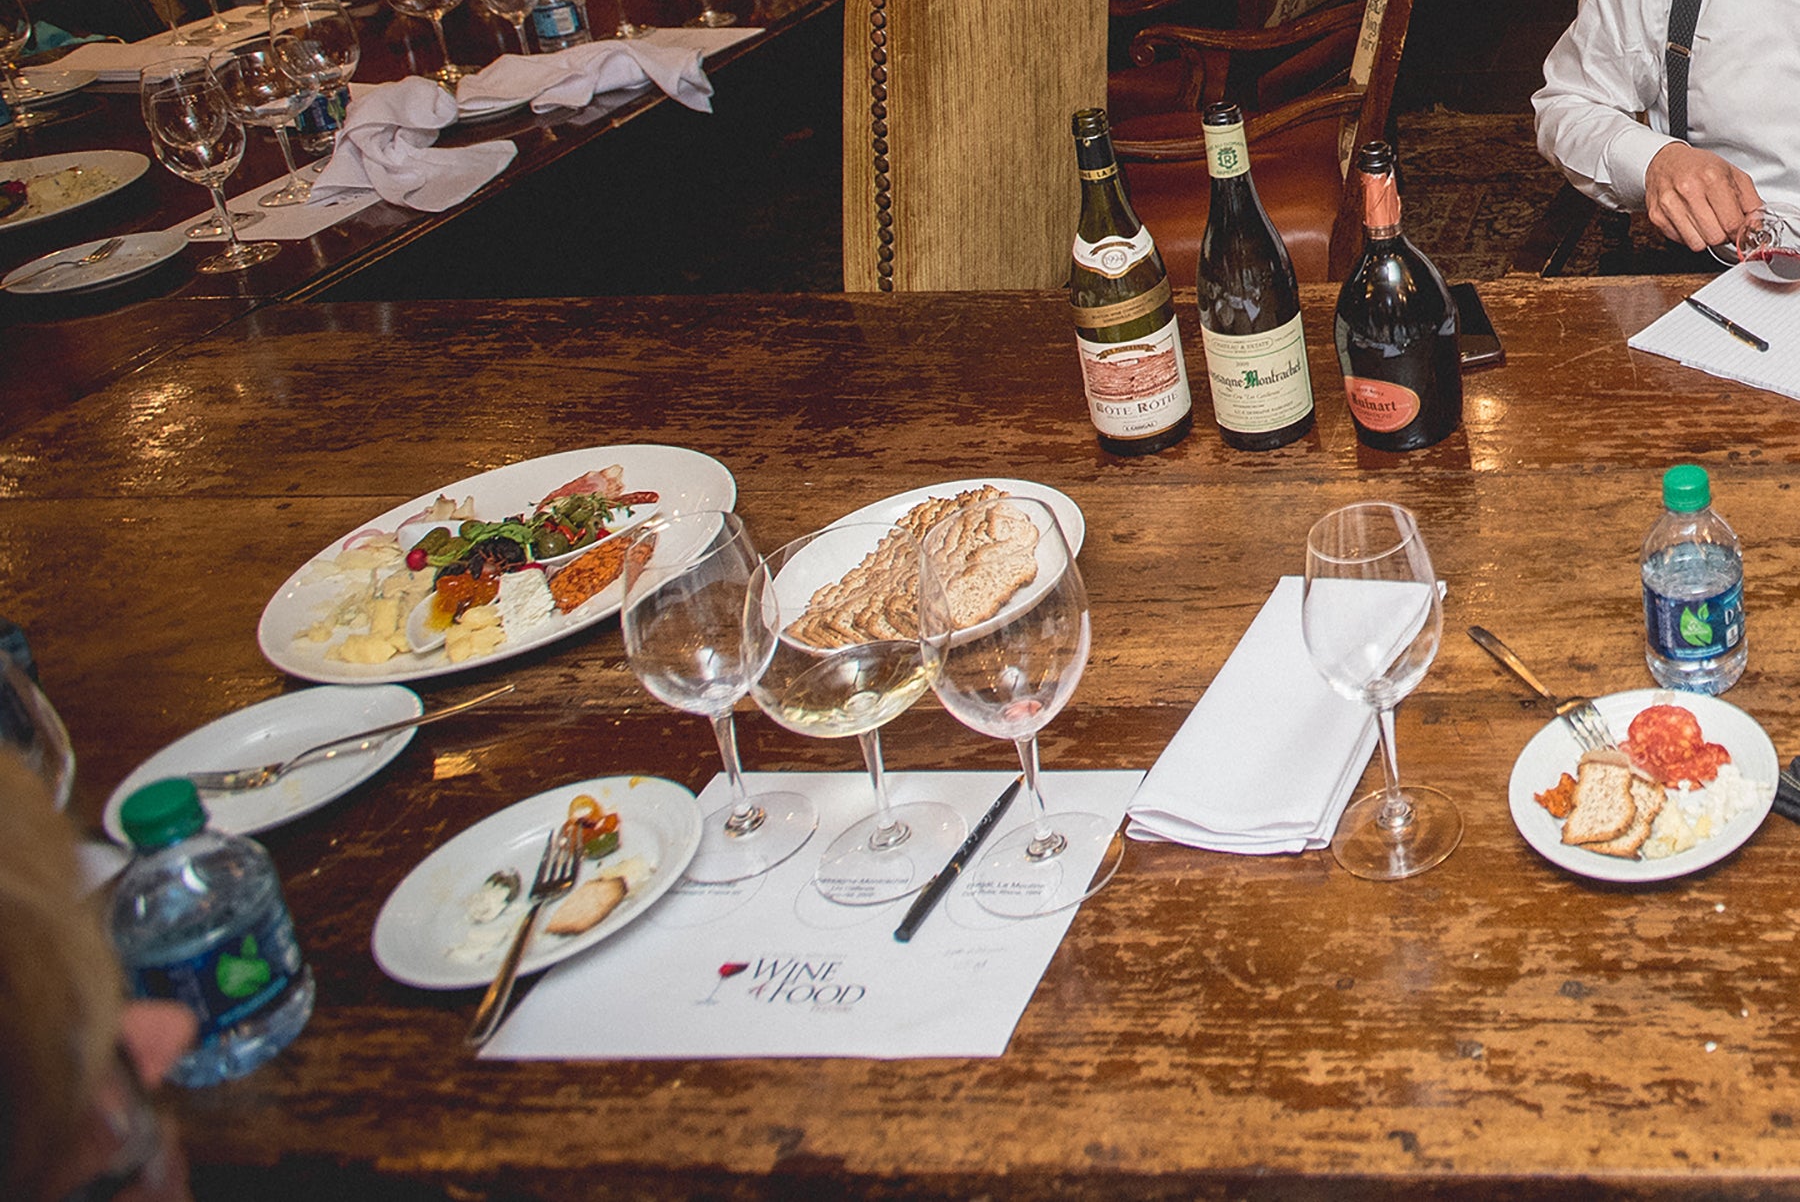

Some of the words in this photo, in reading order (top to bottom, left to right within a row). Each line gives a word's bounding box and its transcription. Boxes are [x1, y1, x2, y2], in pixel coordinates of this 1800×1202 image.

[1351, 392, 1397, 412] Ruinart
[753, 957, 844, 986] WINE
[767, 982, 867, 1005] FOOD
